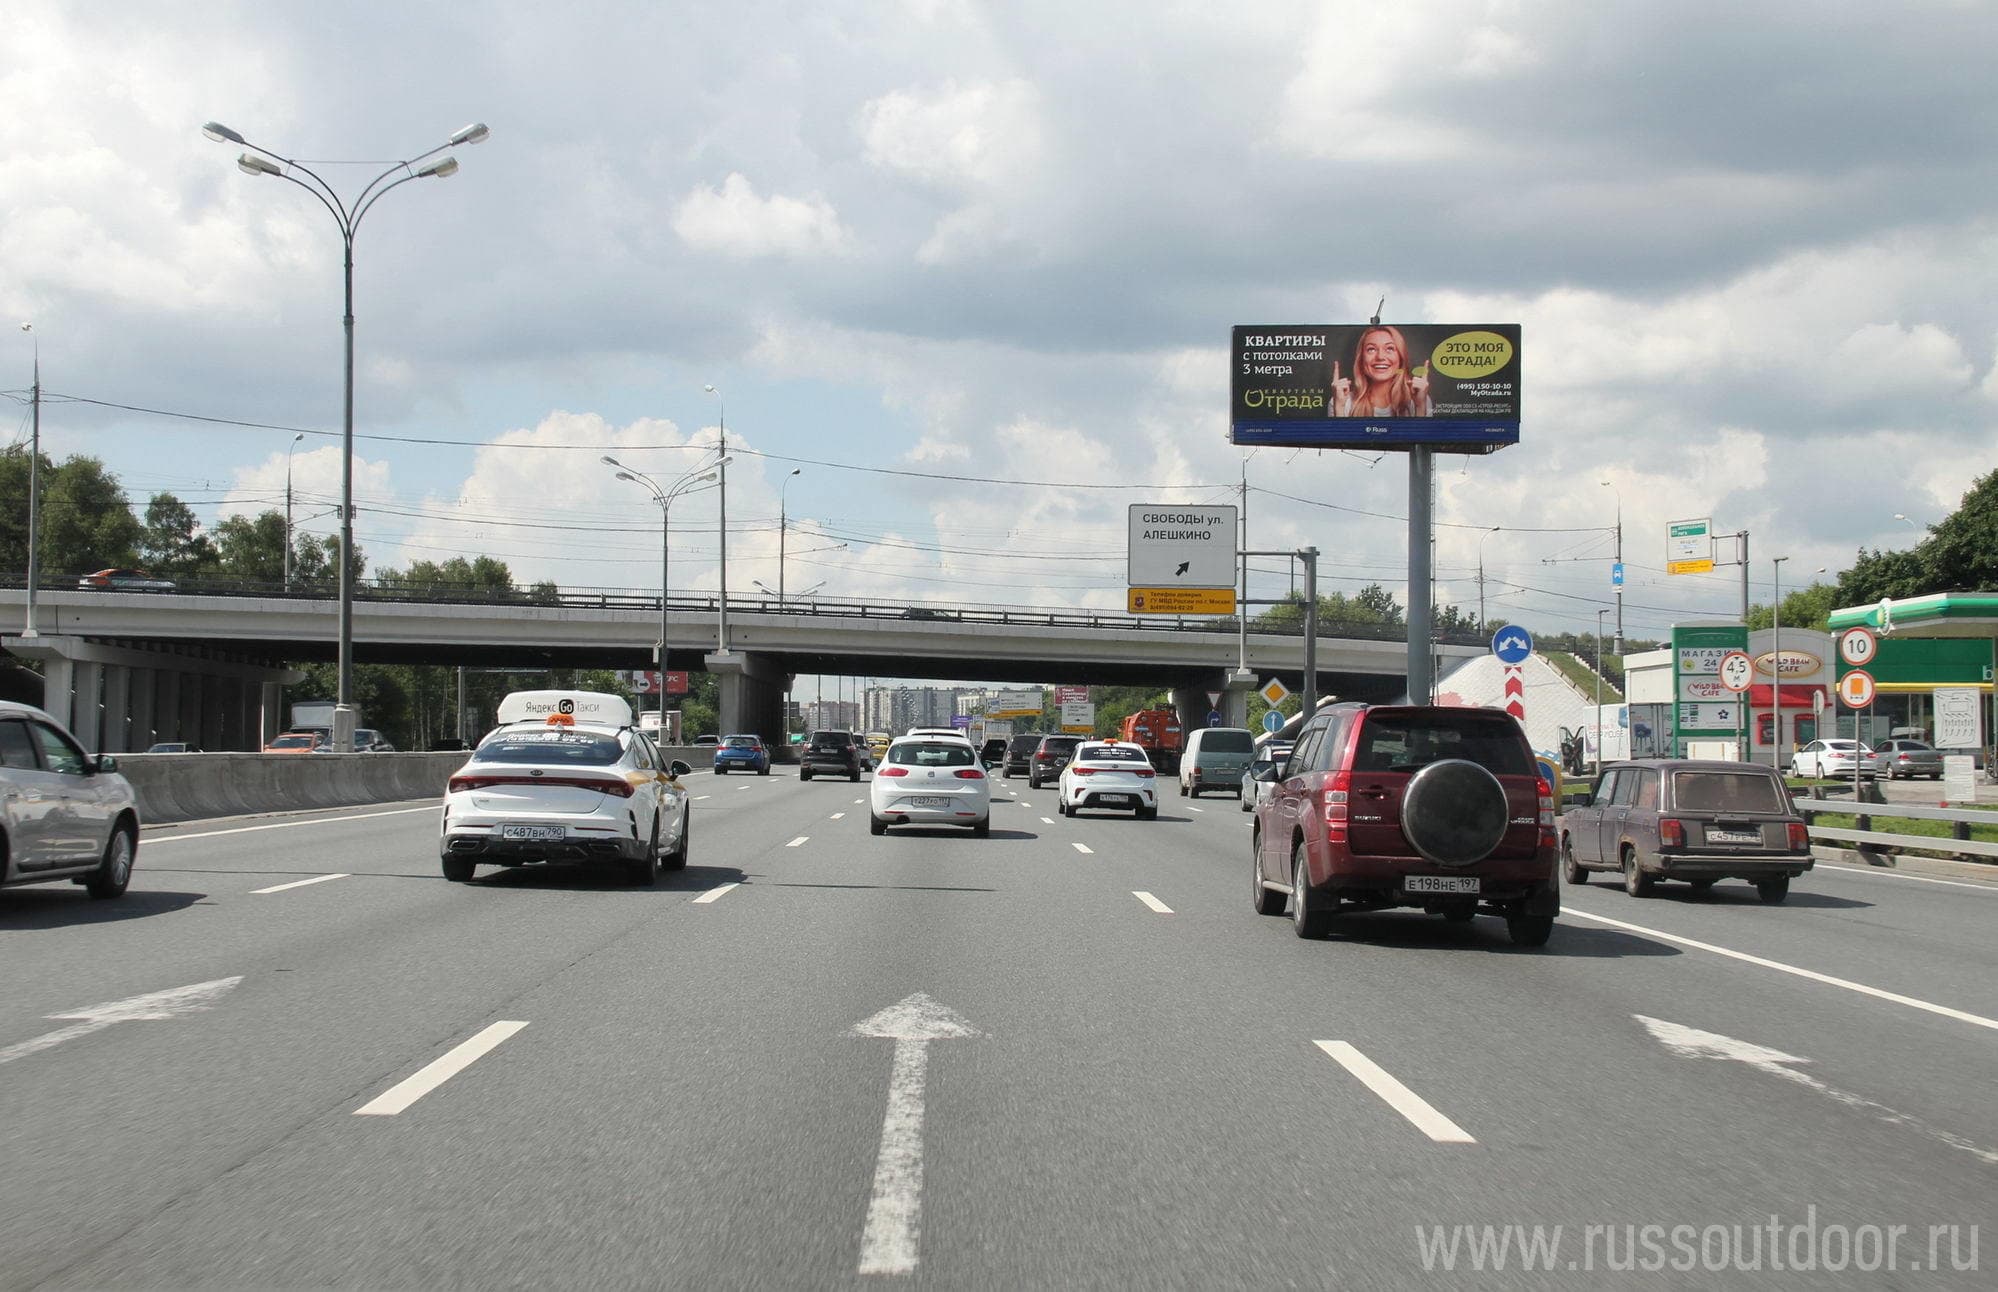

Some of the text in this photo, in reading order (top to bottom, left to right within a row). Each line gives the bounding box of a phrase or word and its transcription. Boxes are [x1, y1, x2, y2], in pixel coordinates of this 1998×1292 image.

[1245, 335, 1327, 347] КВАРТИРЫ
[1446, 343, 1504, 353] ЭТО МОЯ
[1243, 351, 1323, 361] с потолками
[1440, 356, 1496, 368] ОТРАДА!
[1243, 363, 1293, 377] 3 метра
[1456, 383, 1475, 391] (495)
[1244, 389, 1324, 414] Отрада
[1143, 514, 1224, 526] СВОБОДЫ ул.
[1143, 530, 1211, 541] АЛЕШКИНО
[1847, 639, 1867, 654] 10
[1704, 659, 1717, 667] 24
[1726, 661, 1746, 674] 4,5
[525, 701, 600, 714] Яндекс Go Такси
